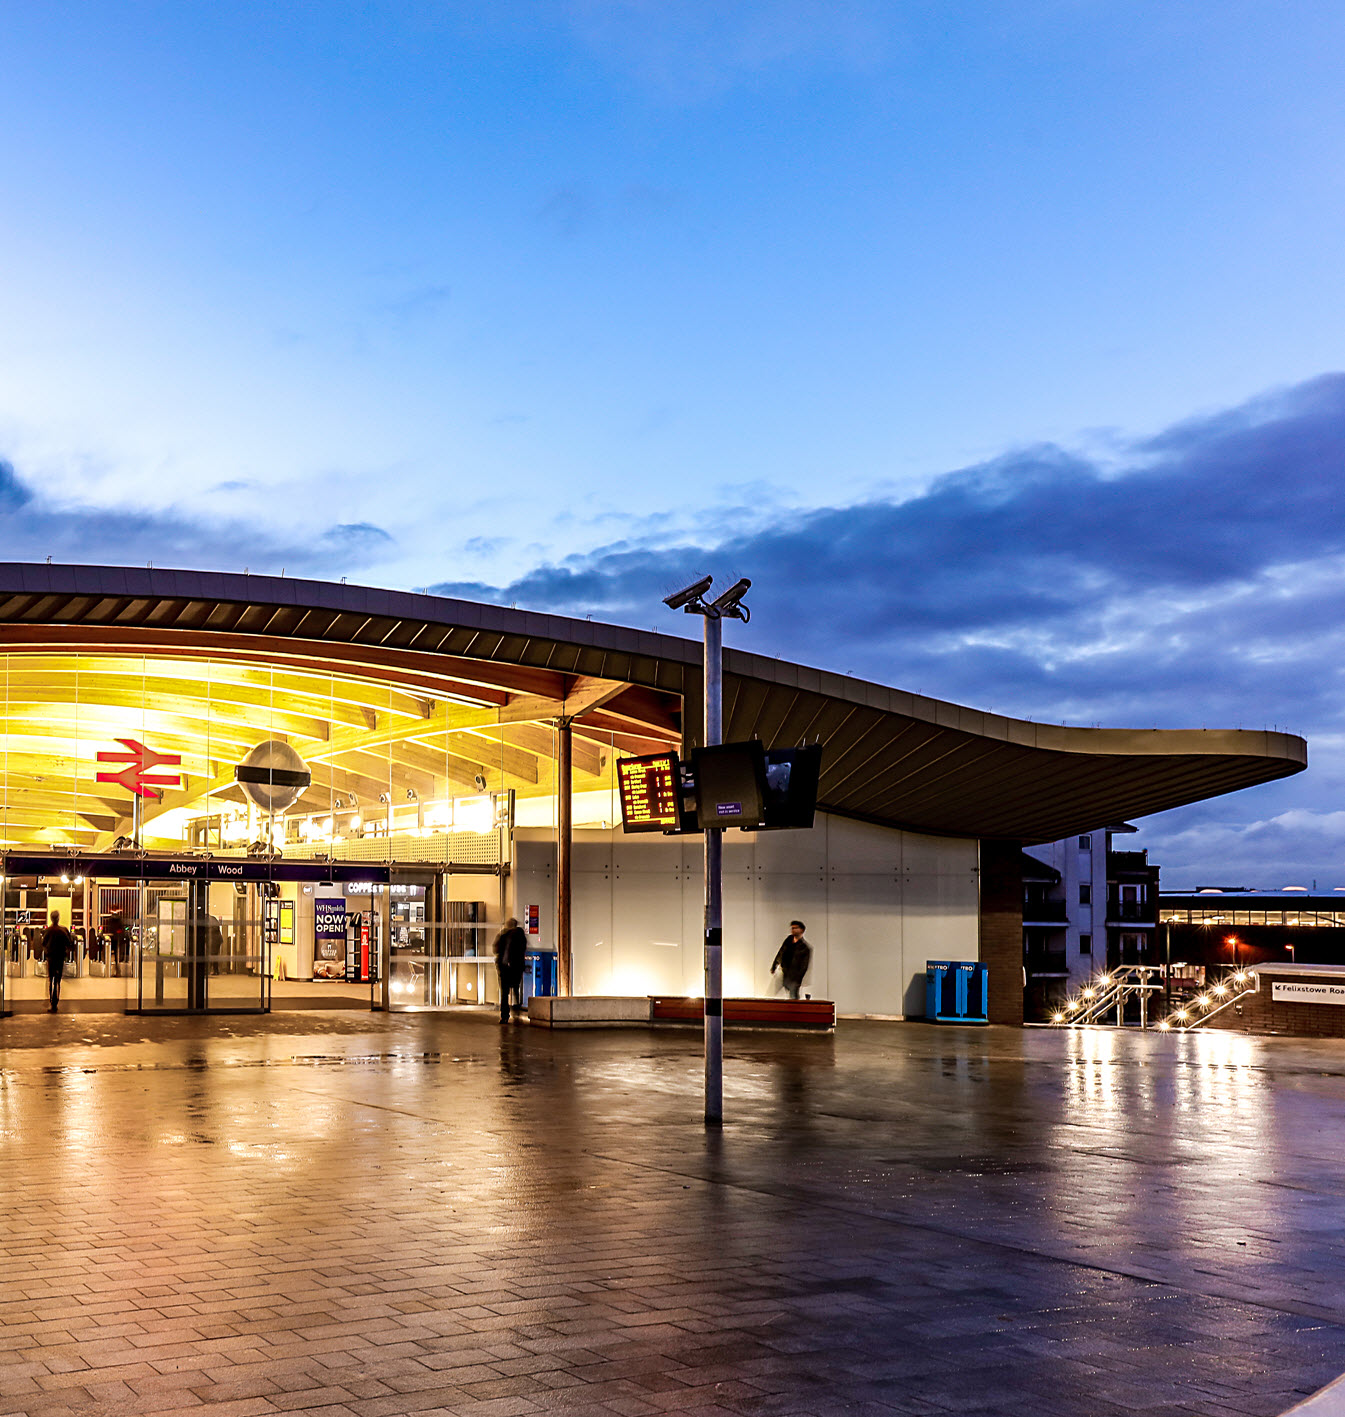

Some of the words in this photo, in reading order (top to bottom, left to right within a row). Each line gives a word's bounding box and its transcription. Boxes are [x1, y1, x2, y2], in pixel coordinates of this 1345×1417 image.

[169, 864, 197, 875] Abbey
[218, 865, 243, 875] Wood
[348, 882, 377, 893] COFFEE
[316, 915, 344, 924] NOW
[316, 924, 344, 933] OPEN!
[1282, 984, 1327, 994] Felixstowe
